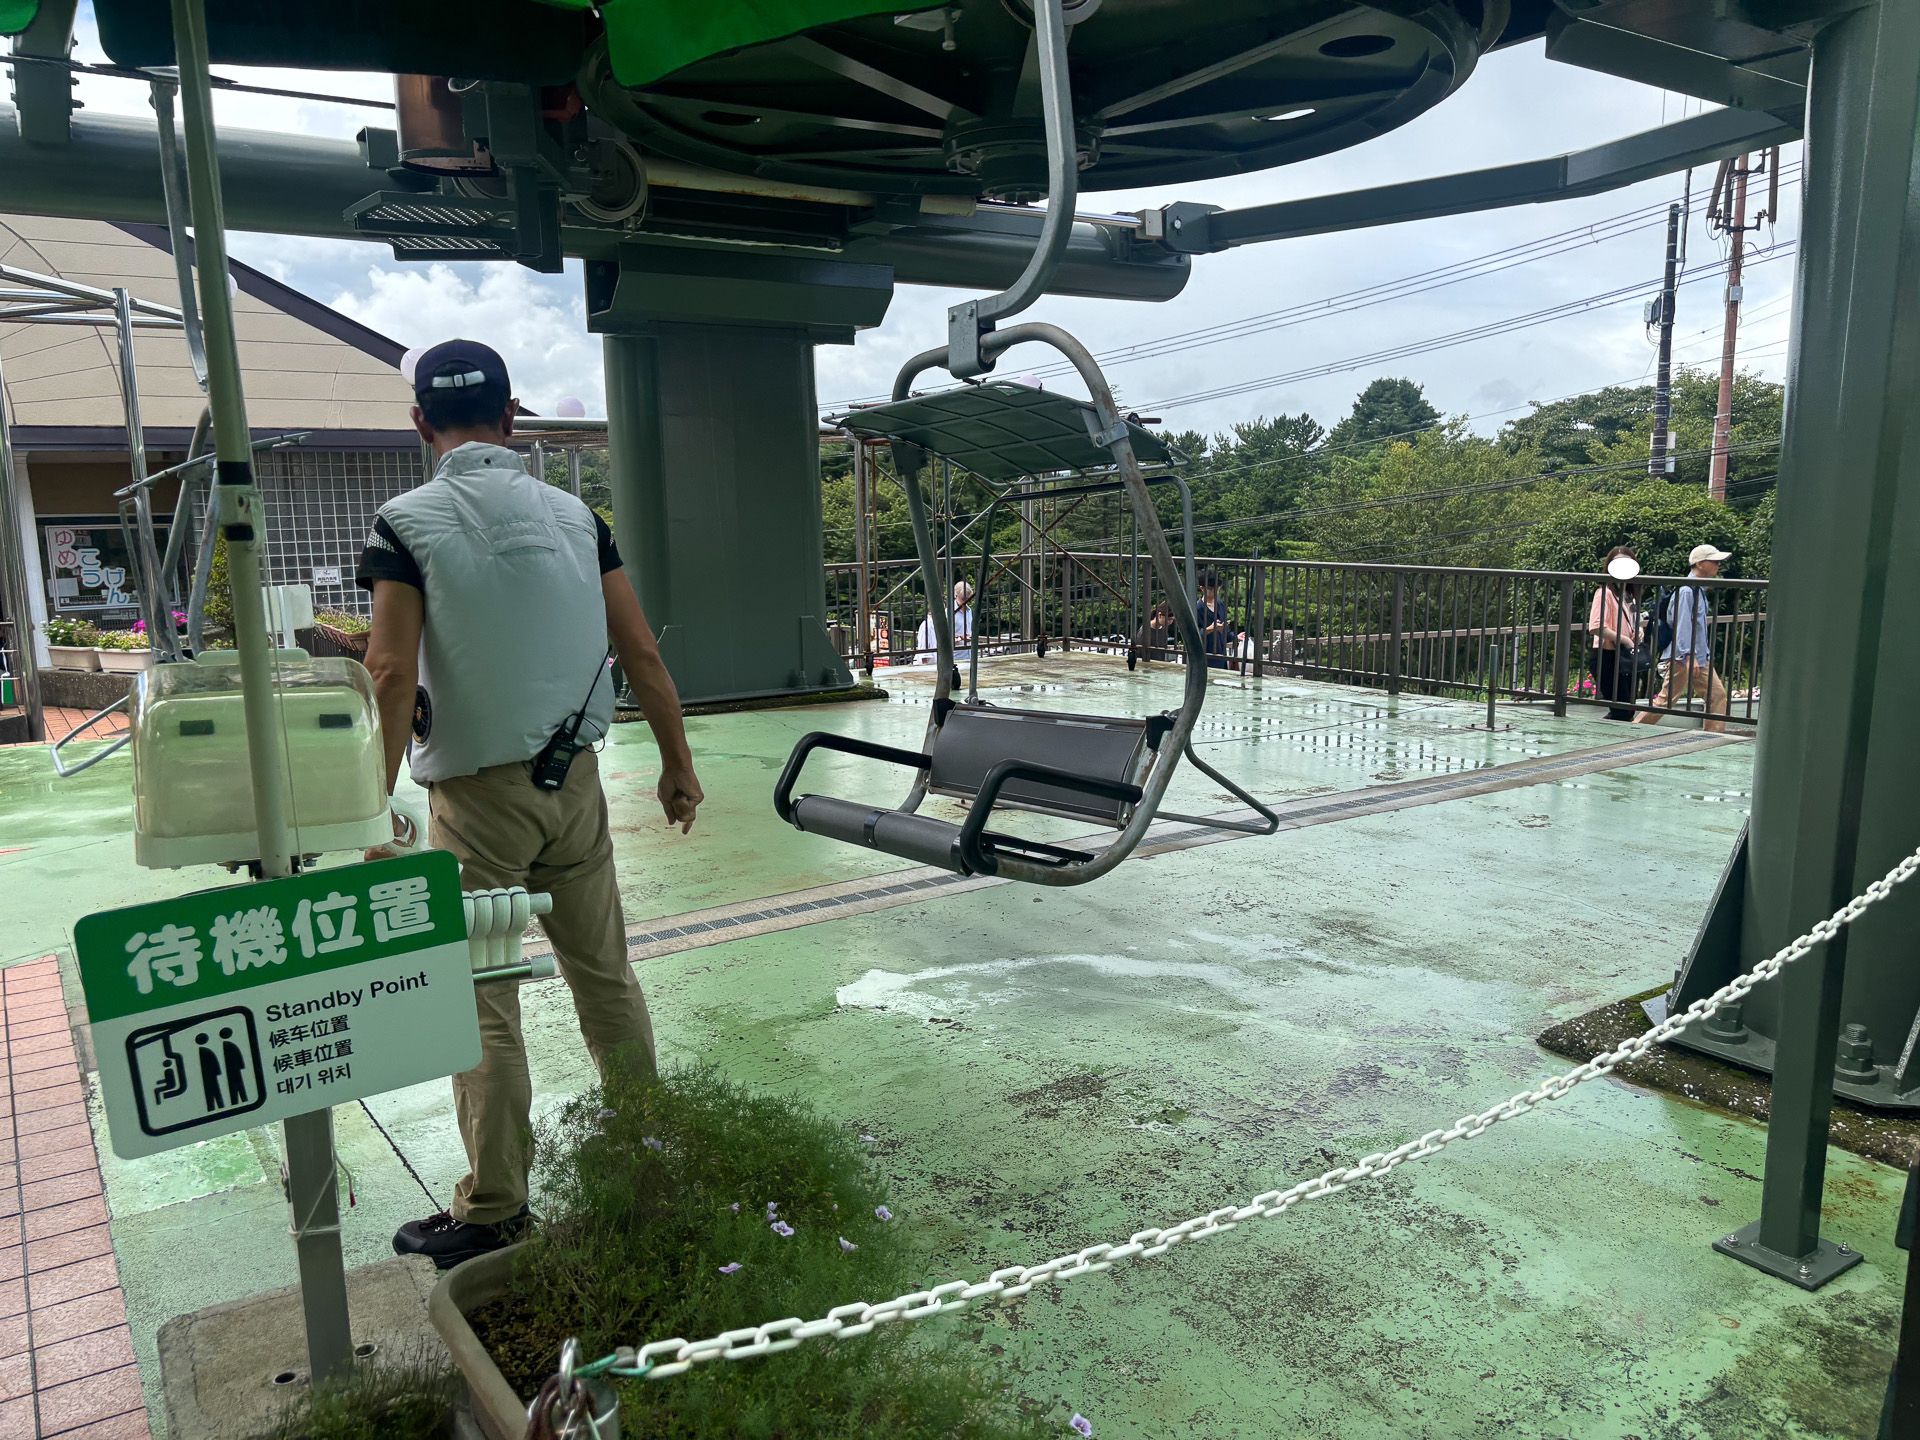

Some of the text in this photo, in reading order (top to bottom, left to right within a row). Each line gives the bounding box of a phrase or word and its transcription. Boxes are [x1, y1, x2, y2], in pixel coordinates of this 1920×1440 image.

[125, 876, 435, 994] 待機位置
[266, 971, 429, 1022] Standby Point
[269, 1014, 351, 1049] 候车位置
[273, 1039, 354, 1073] 候車位置
[277, 1063, 351, 1094] 대기 위치
